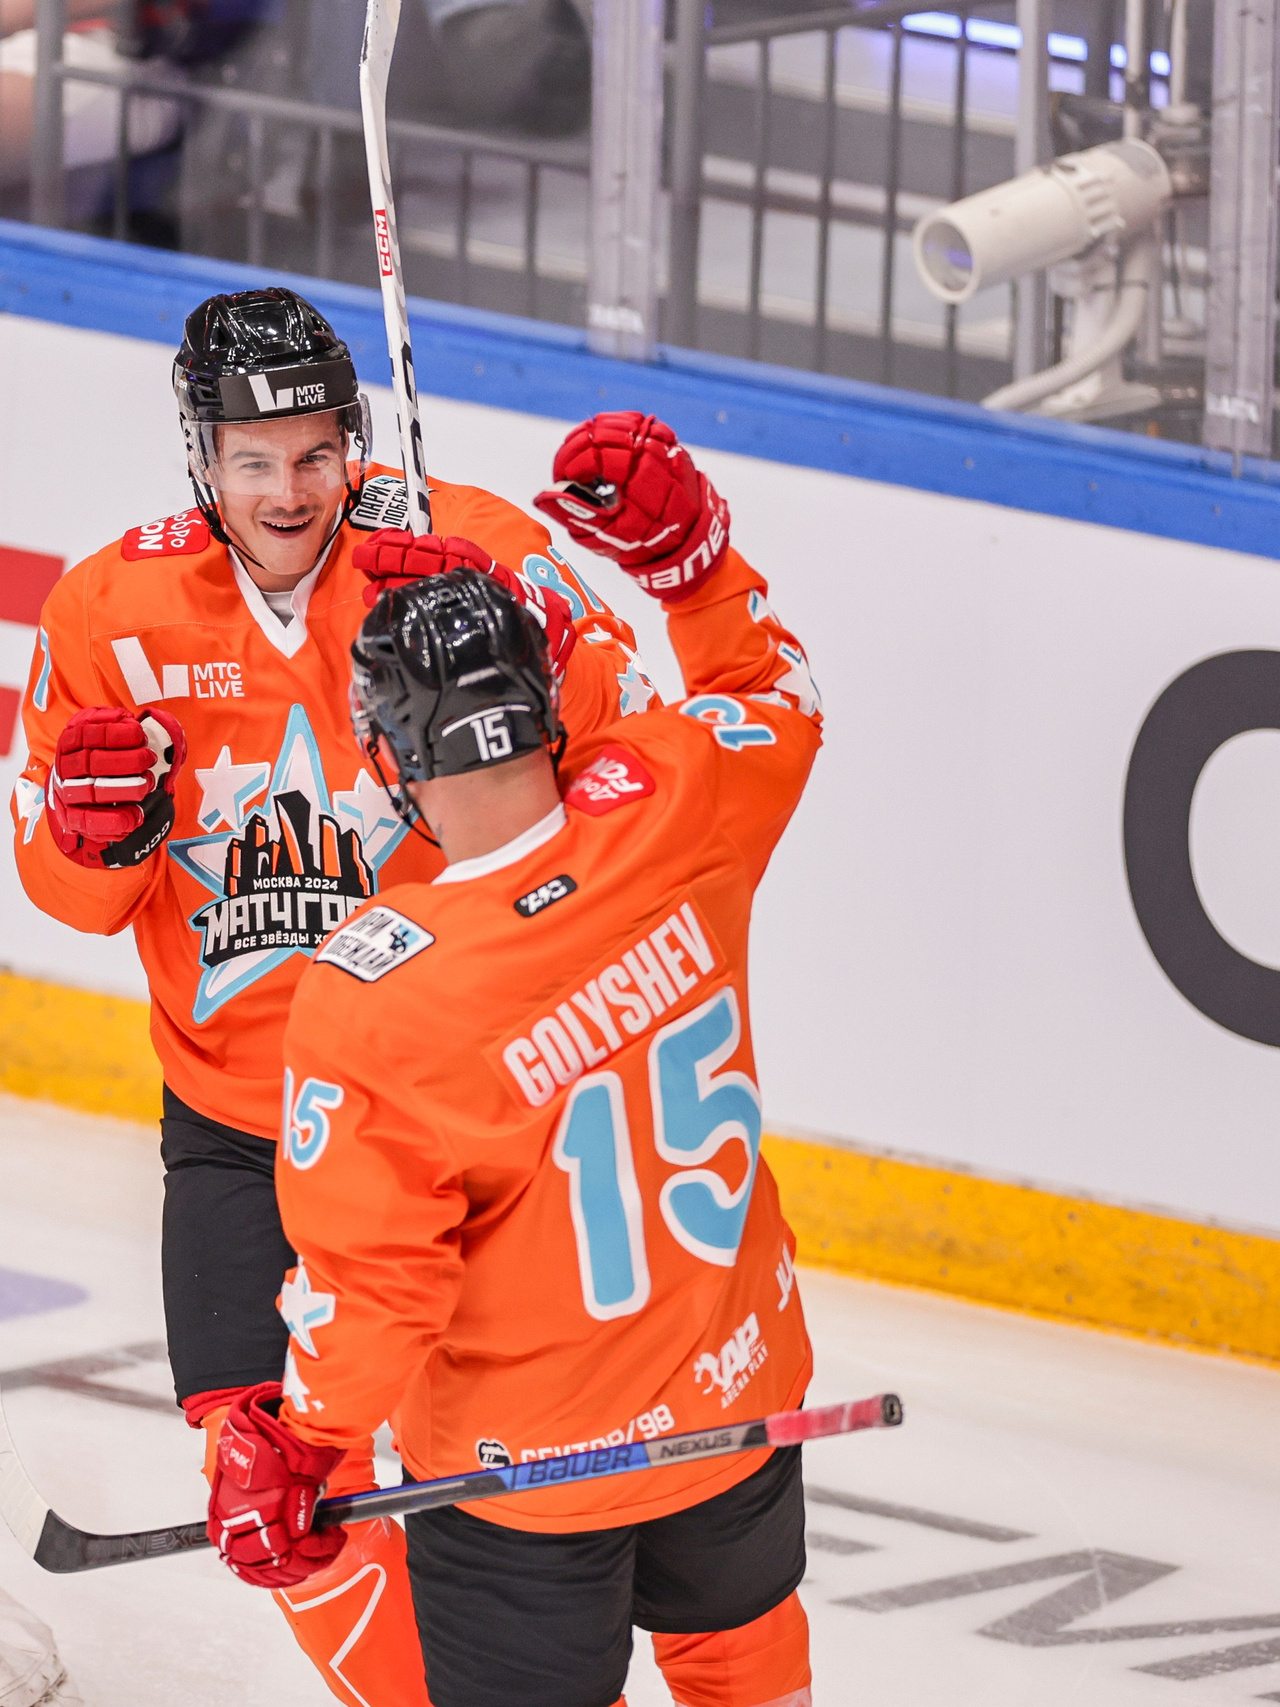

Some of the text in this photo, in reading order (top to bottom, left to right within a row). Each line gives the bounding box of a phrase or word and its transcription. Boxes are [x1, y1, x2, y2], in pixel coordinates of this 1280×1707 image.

[376, 211, 392, 274] CCM
[297, 393, 326, 407] LIVE
[355, 484, 392, 521] ПАРИ
[137, 518, 167, 551] ON
[194, 680, 245, 699] LIVE
[469, 711, 513, 762] 15
[134, 820, 170, 860] CCM
[253, 877, 339, 891] МОСКВА 2024
[234, 936, 257, 950] ВСЕ
[261, 930, 310, 946] ЗВЁЗДЫ
[502, 901, 716, 1108] GOLYSHEV
[552, 984, 762, 1322] 15
[748, 1342, 770, 1377] PLAY
[658, 1431, 733, 1459] NEXUS
